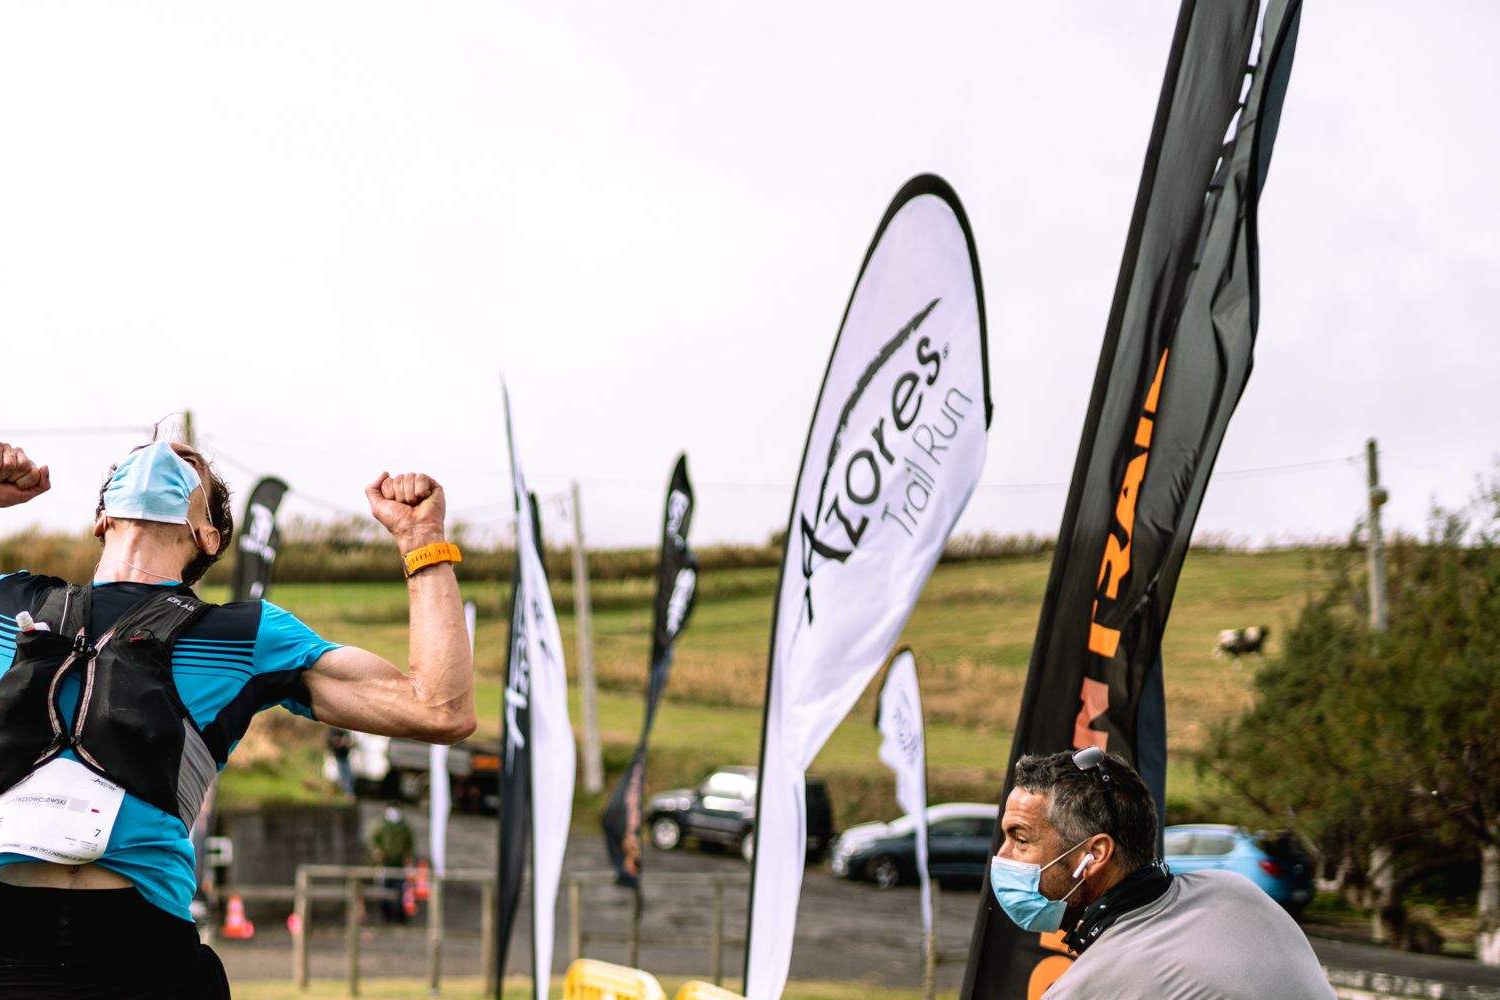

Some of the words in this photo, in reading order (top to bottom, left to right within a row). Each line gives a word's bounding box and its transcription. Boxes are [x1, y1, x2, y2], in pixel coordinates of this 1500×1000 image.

[801, 336, 942, 626] Azores
[880, 457, 936, 537] Trail
[911, 386, 973, 465] Run
